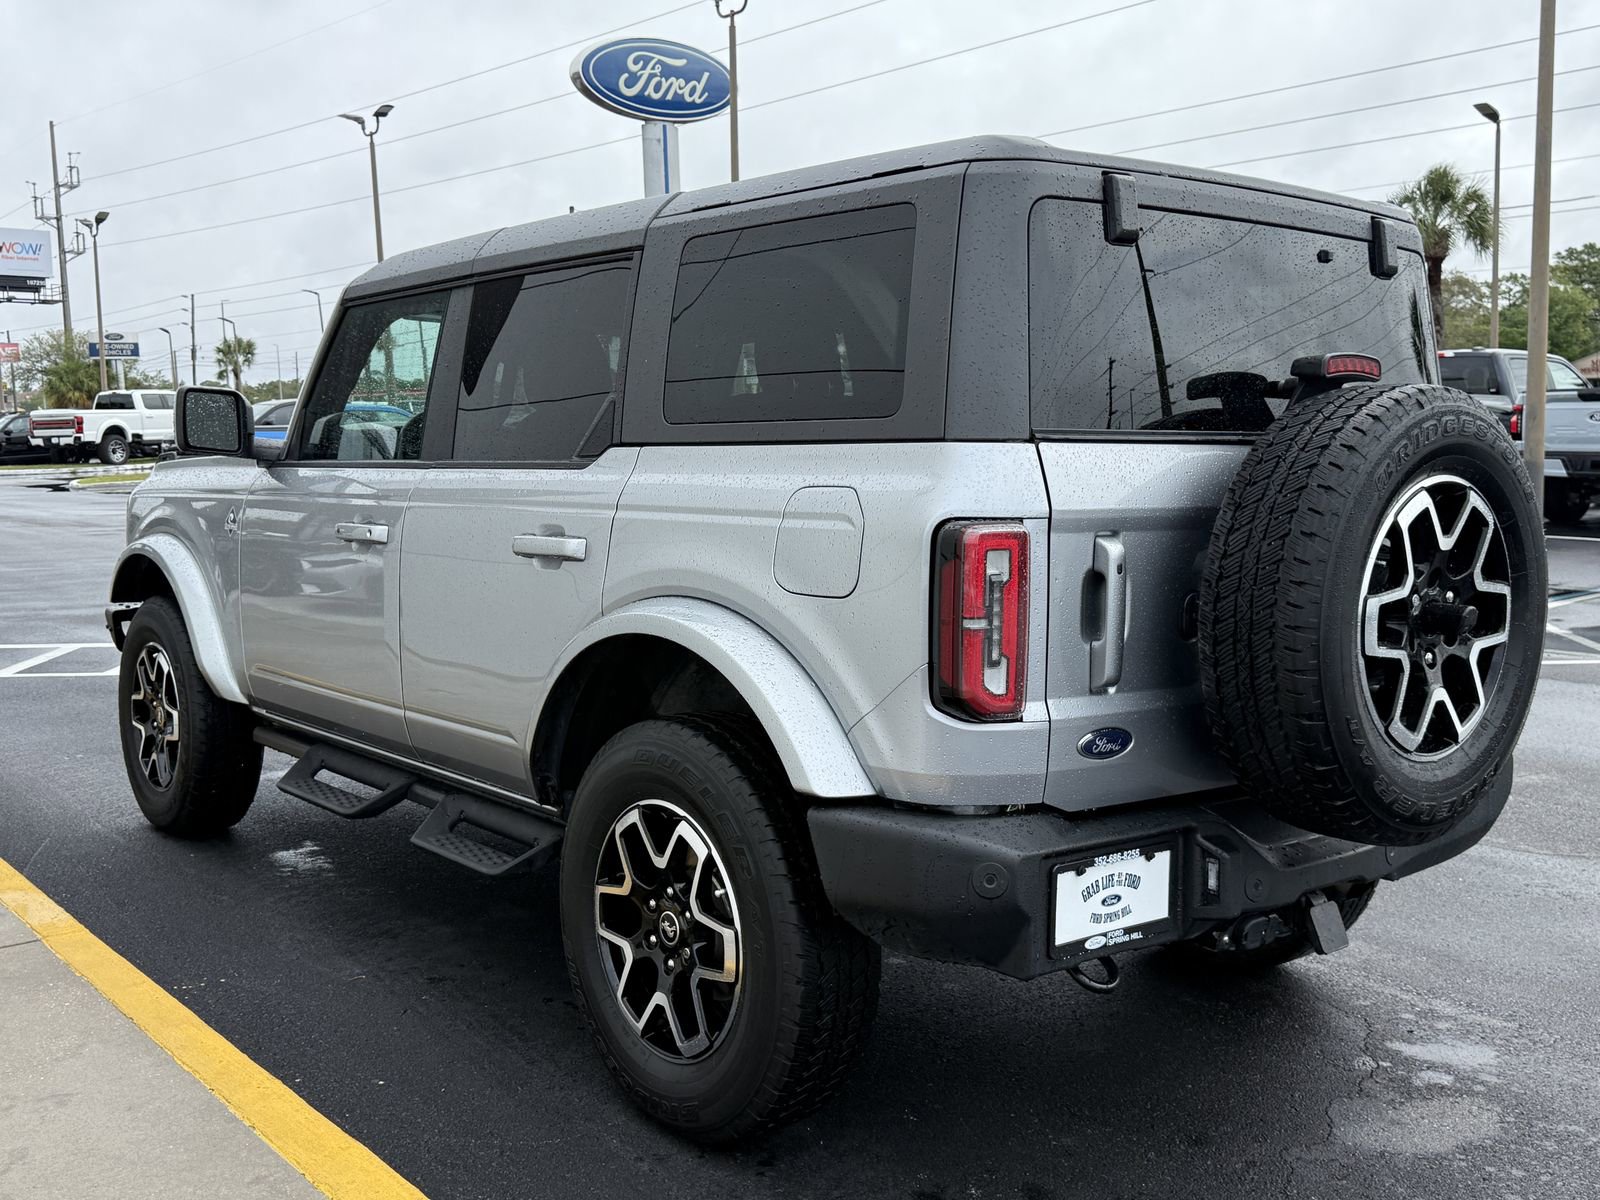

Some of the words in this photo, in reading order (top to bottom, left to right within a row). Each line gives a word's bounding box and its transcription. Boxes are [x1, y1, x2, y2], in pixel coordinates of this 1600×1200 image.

[619, 51, 710, 104] Ford
[1092, 736, 1121, 753] Ford
[633, 750, 753, 880] DUELER
[1081, 879, 1101, 903] GRAB
[1101, 873, 1116, 890] LIFE
[1123, 872, 1141, 890] FORD
[1089, 912, 1103, 924] FORD
[1103, 909, 1121, 924] SPRING
[1108, 929, 1124, 938] FORD
[1108, 934, 1130, 946] SPRING
[1130, 931, 1143, 940] HILL
